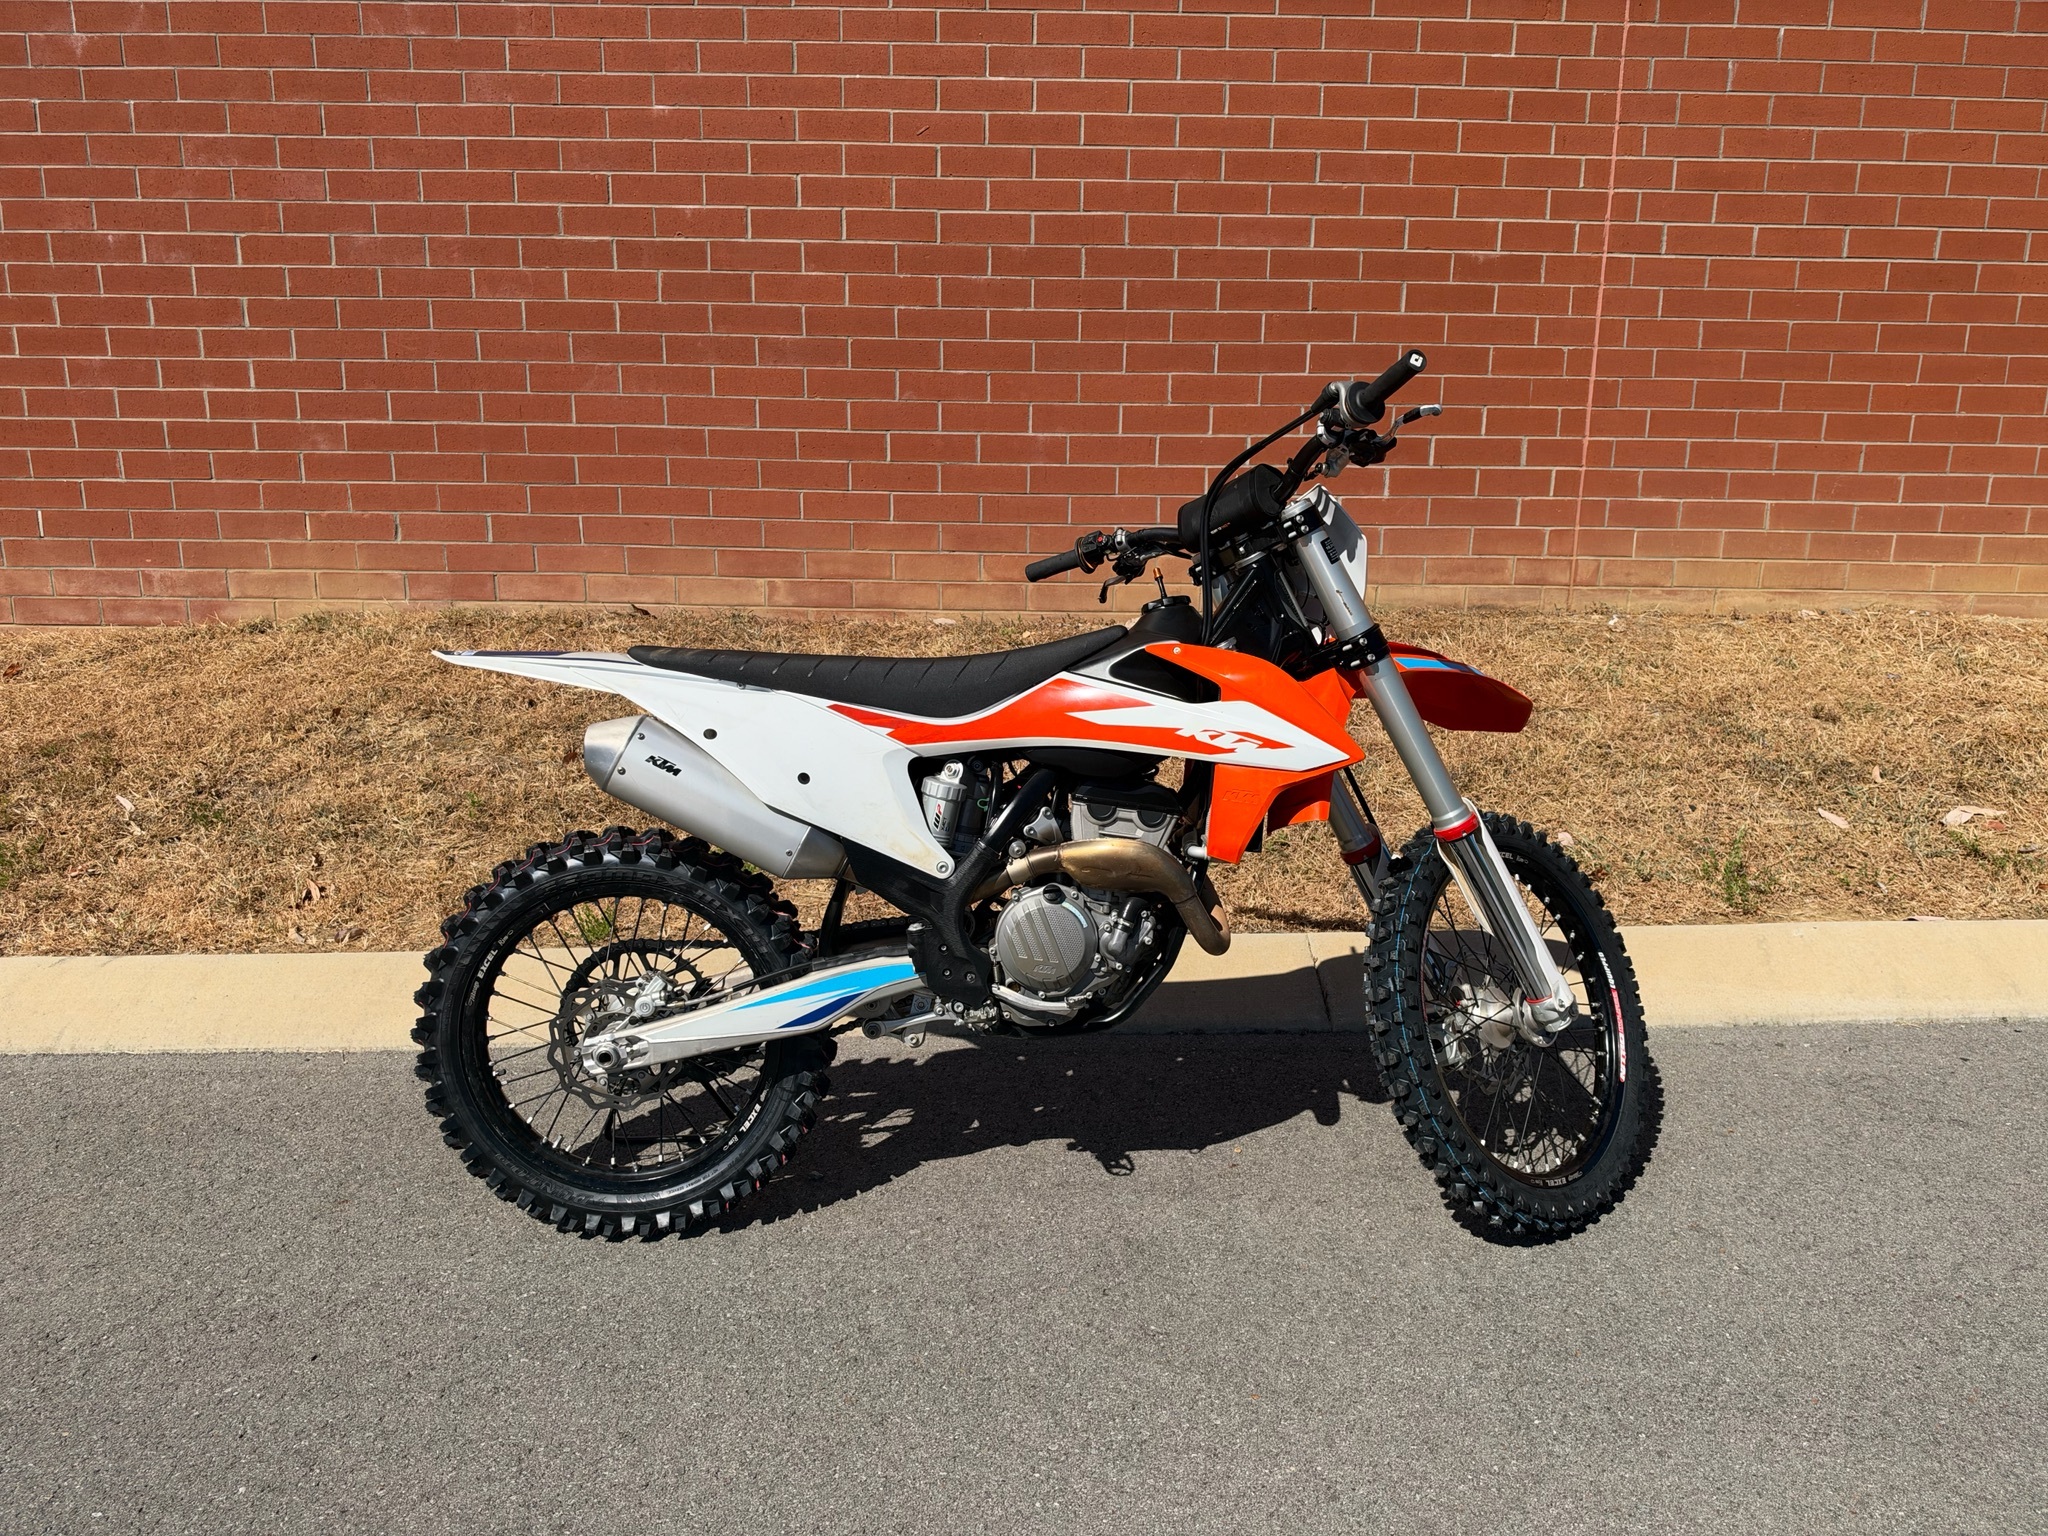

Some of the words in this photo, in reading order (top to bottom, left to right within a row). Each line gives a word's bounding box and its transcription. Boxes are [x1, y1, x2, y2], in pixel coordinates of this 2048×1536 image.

[645, 755, 682, 776] KTM
[477, 949, 498, 979] EXCEL
[1598, 952, 1616, 989] EQUIPPED
[739, 1103, 762, 1132] EXCEL
[1545, 1177, 1567, 1187] EXCEL
